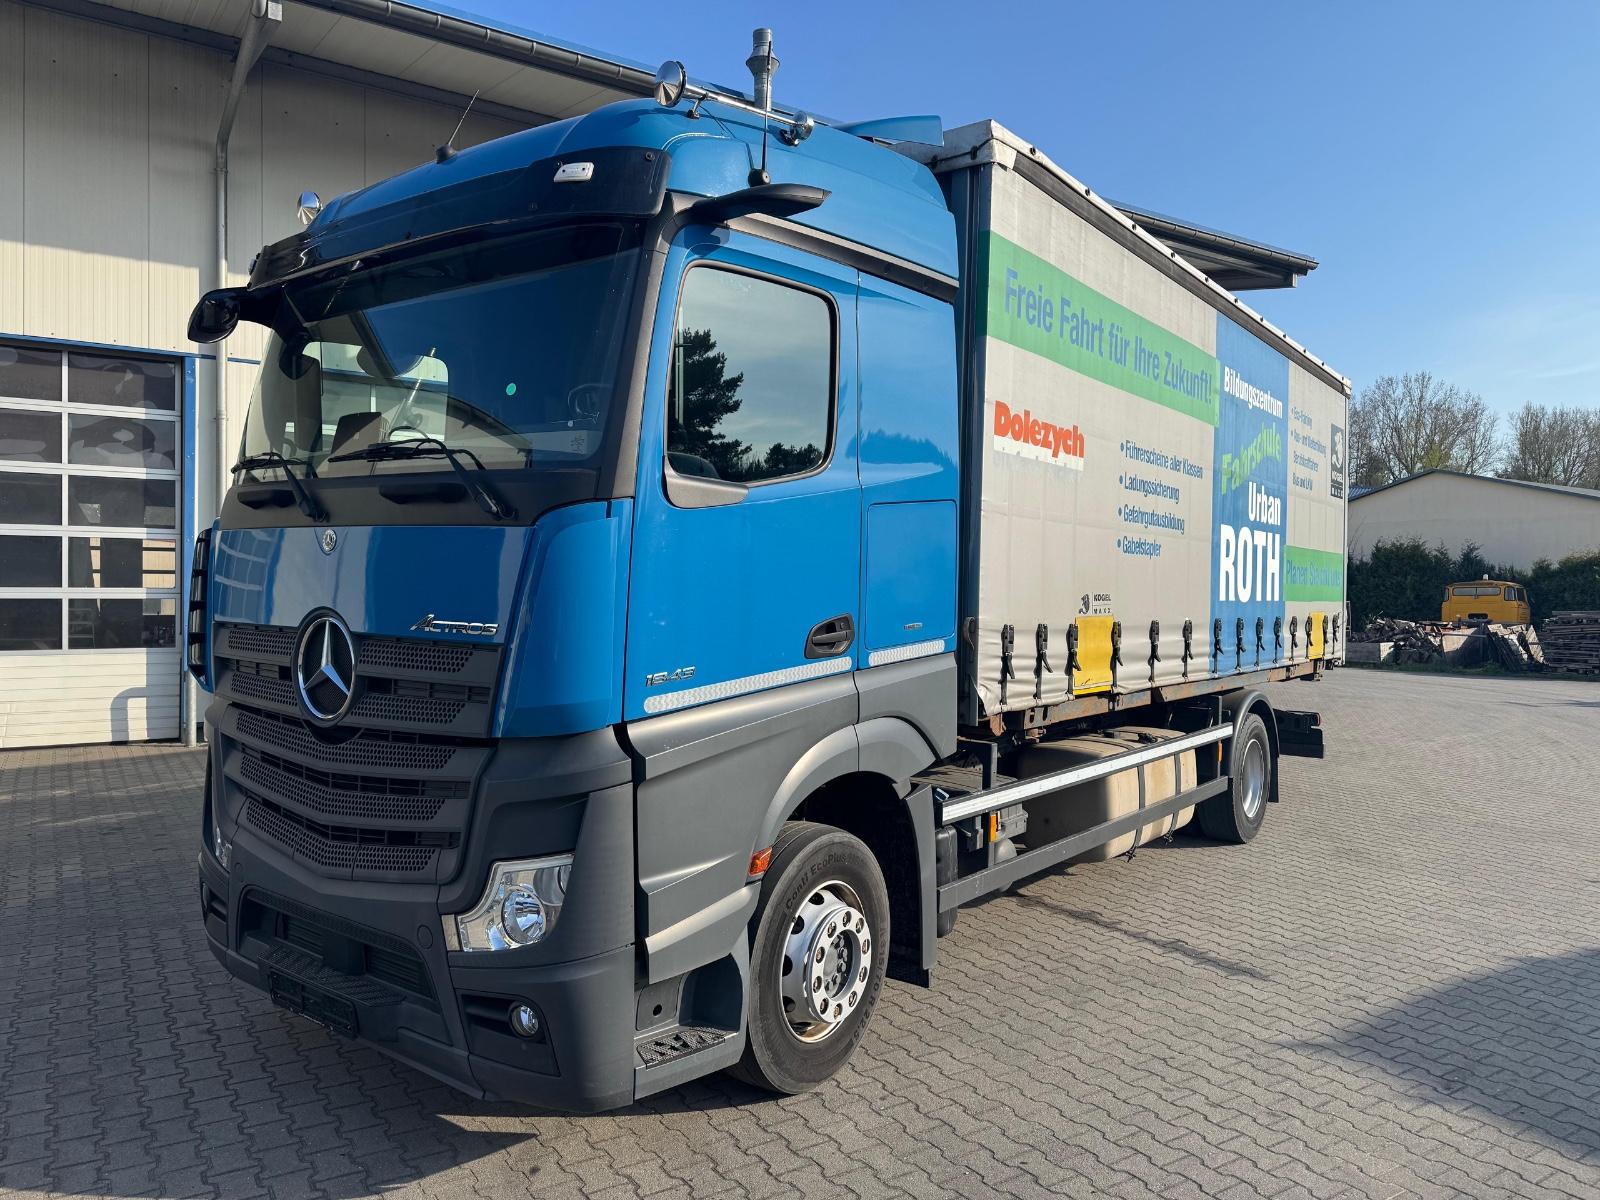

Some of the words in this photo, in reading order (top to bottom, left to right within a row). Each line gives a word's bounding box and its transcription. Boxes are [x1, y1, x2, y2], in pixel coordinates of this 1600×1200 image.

[1004, 267, 1053, 333] Freie
[1059, 296, 1104, 358] Fahrt
[1108, 322, 1130, 367] für
[1134, 335, 1160, 381] Ihre
[1164, 351, 1212, 405] Zukunft!
[1224, 366, 1283, 419] Bildungszentrum
[993, 400, 1085, 458] Dolezych
[1125, 440, 1168, 469] Führerscheine
[1169, 456, 1182, 473] aller
[1182, 458, 1203, 479] Klassen
[1124, 472, 1179, 504] Ladungssicherung
[1248, 481, 1281, 526] Urban
[1123, 504, 1185, 535] Gefahrgutausbildung
[1122, 536, 1161, 559] Gabelstapler
[1219, 524, 1280, 603] ROTH
